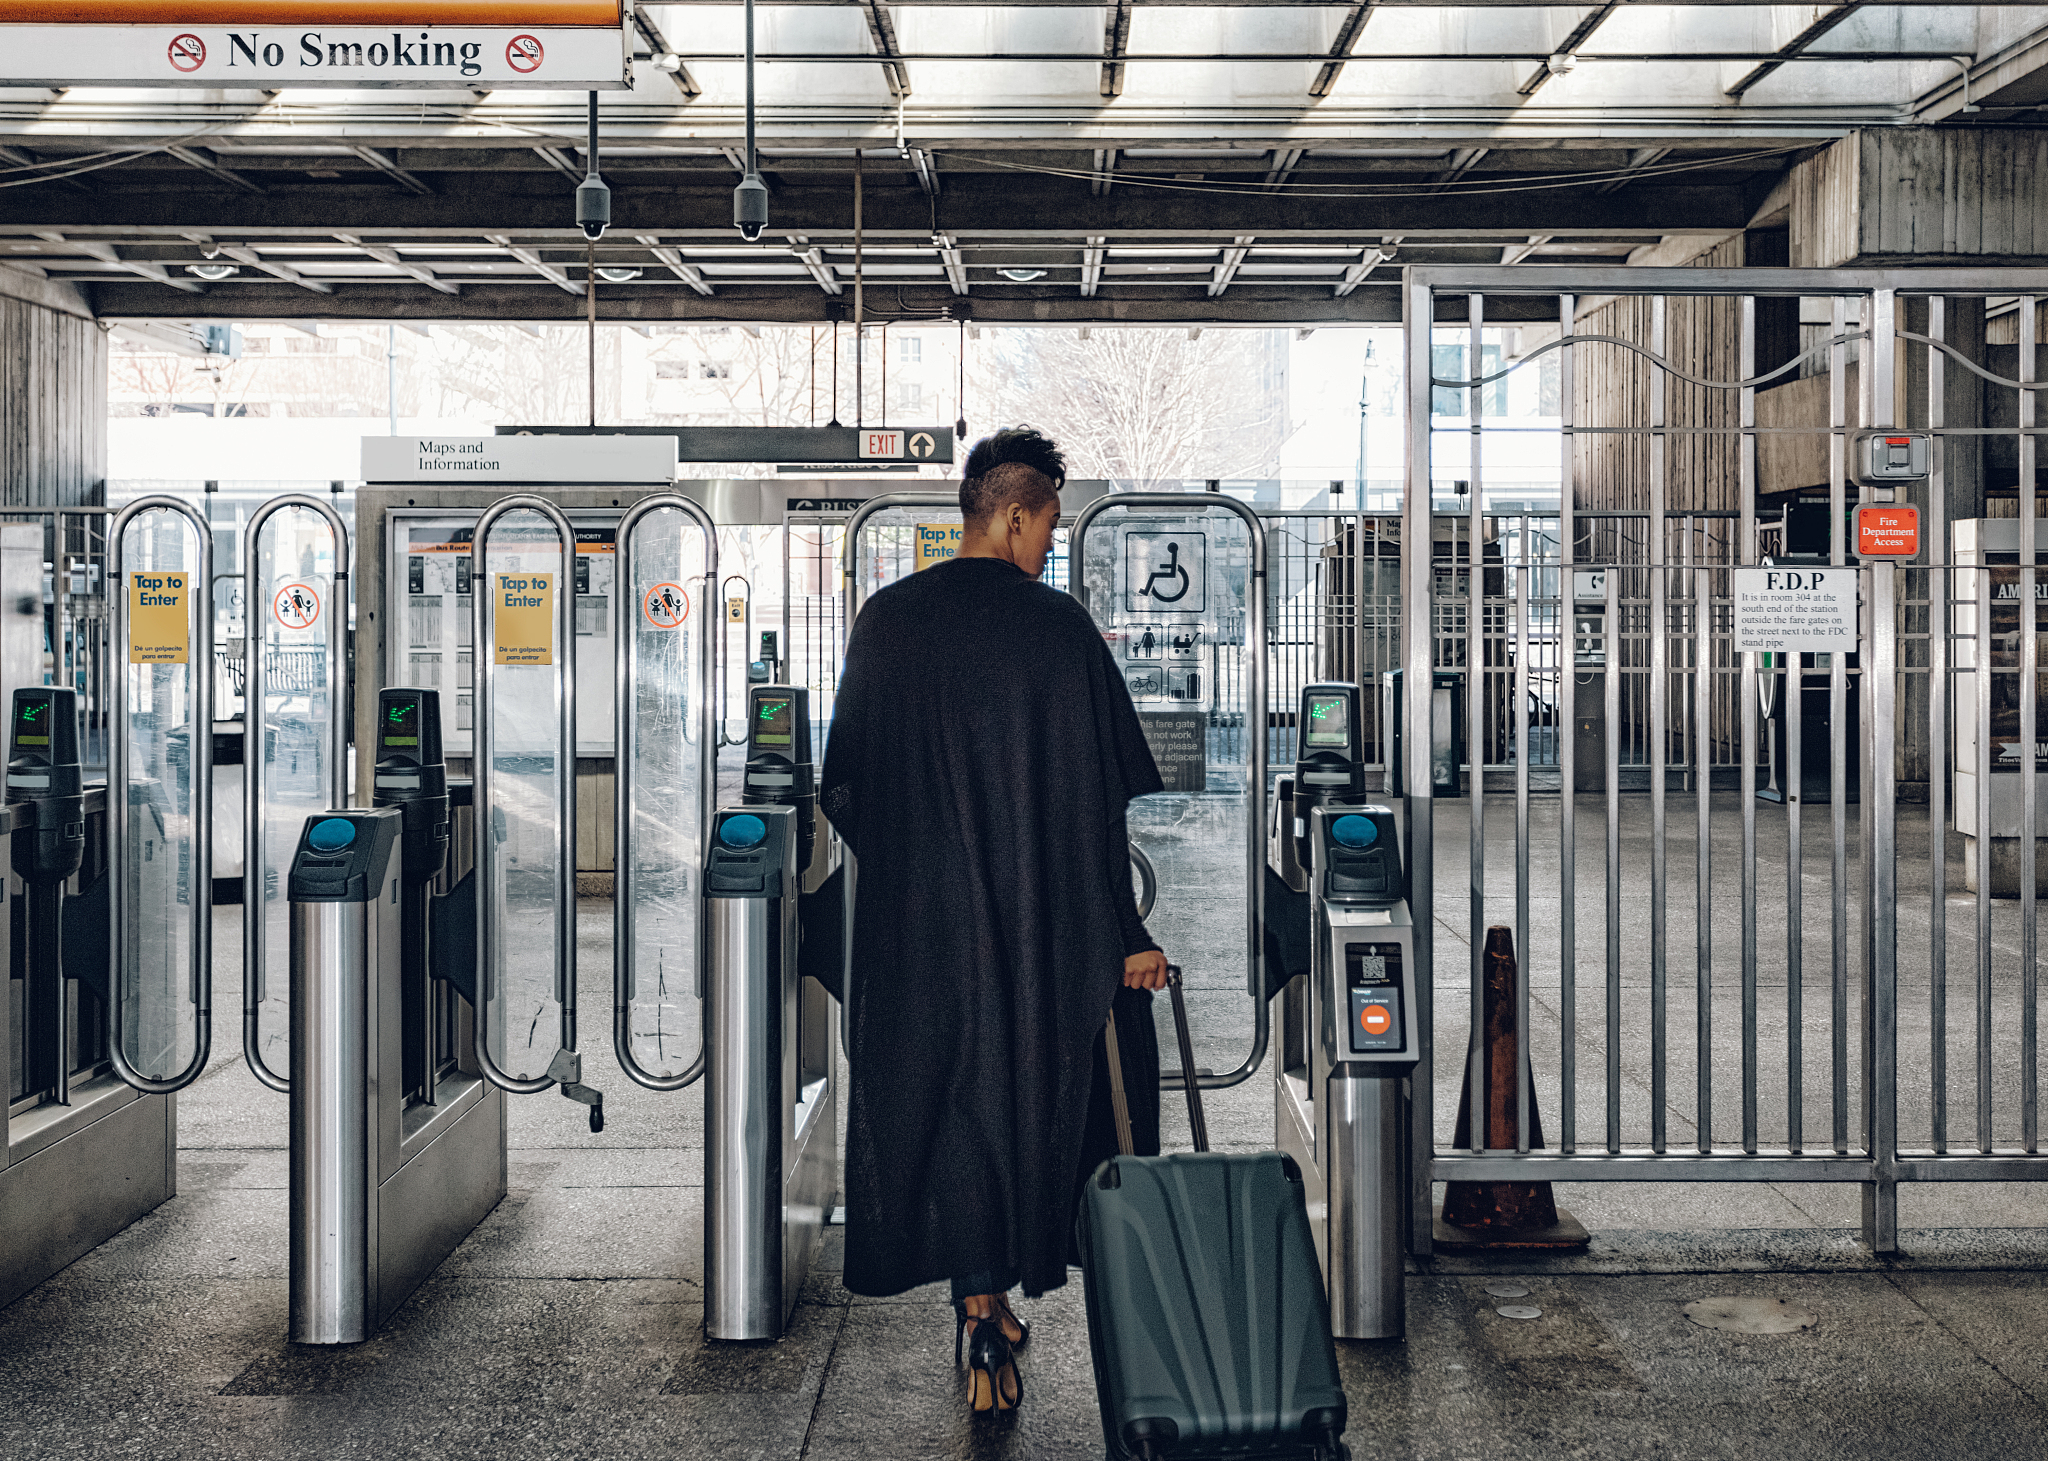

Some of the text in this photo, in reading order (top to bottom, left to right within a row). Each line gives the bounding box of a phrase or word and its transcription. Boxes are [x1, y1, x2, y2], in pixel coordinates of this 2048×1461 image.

[226, 32, 482, 76] No Smoking
[419, 441, 483, 456] Maps and
[869, 434, 897, 455] EXIT
[419, 457, 500, 470] Information
[1879, 517, 1898, 526] Fire
[918, 526, 946, 544] Tap
[1862, 527, 1915, 538] Department
[1874, 538, 1904, 546] Access
[924, 544, 957, 558] Ente
[134, 575, 182, 592] Tap to
[500, 576, 548, 593] Tap to
[1765, 572, 1825, 590] F.D.P
[140, 592, 178, 606] Enter
[505, 593, 544, 607] Enter
[1742, 593, 1748, 601] It
[1750, 593, 1758, 601] is
[1760, 593, 1768, 601] in
[1795, 594, 1811, 602] 304
[1824, 594, 1836, 602] the
[1742, 604, 1764, 612] south
[1766, 604, 1781, 612] end
[1784, 604, 1794, 612] of
[1796, 604, 1808, 612] the
[1742, 616, 1772, 624] outside
[1774, 616, 1787, 624] the
[1790, 616, 1806, 624] fare
[1808, 618, 1829, 626] gates
[1742, 628, 1754, 636] the
[1756, 628, 1780, 636] street
[1813, 628, 1826, 636] the
[1828, 628, 1848, 636] FDC
[1742, 638, 1784, 648] stand pipe
[1140, 720, 1196, 730] his fare gate
[1170, 730, 1192, 739] work
[1168, 742, 1198, 752] please
[1164, 752, 1203, 763] adjacent
